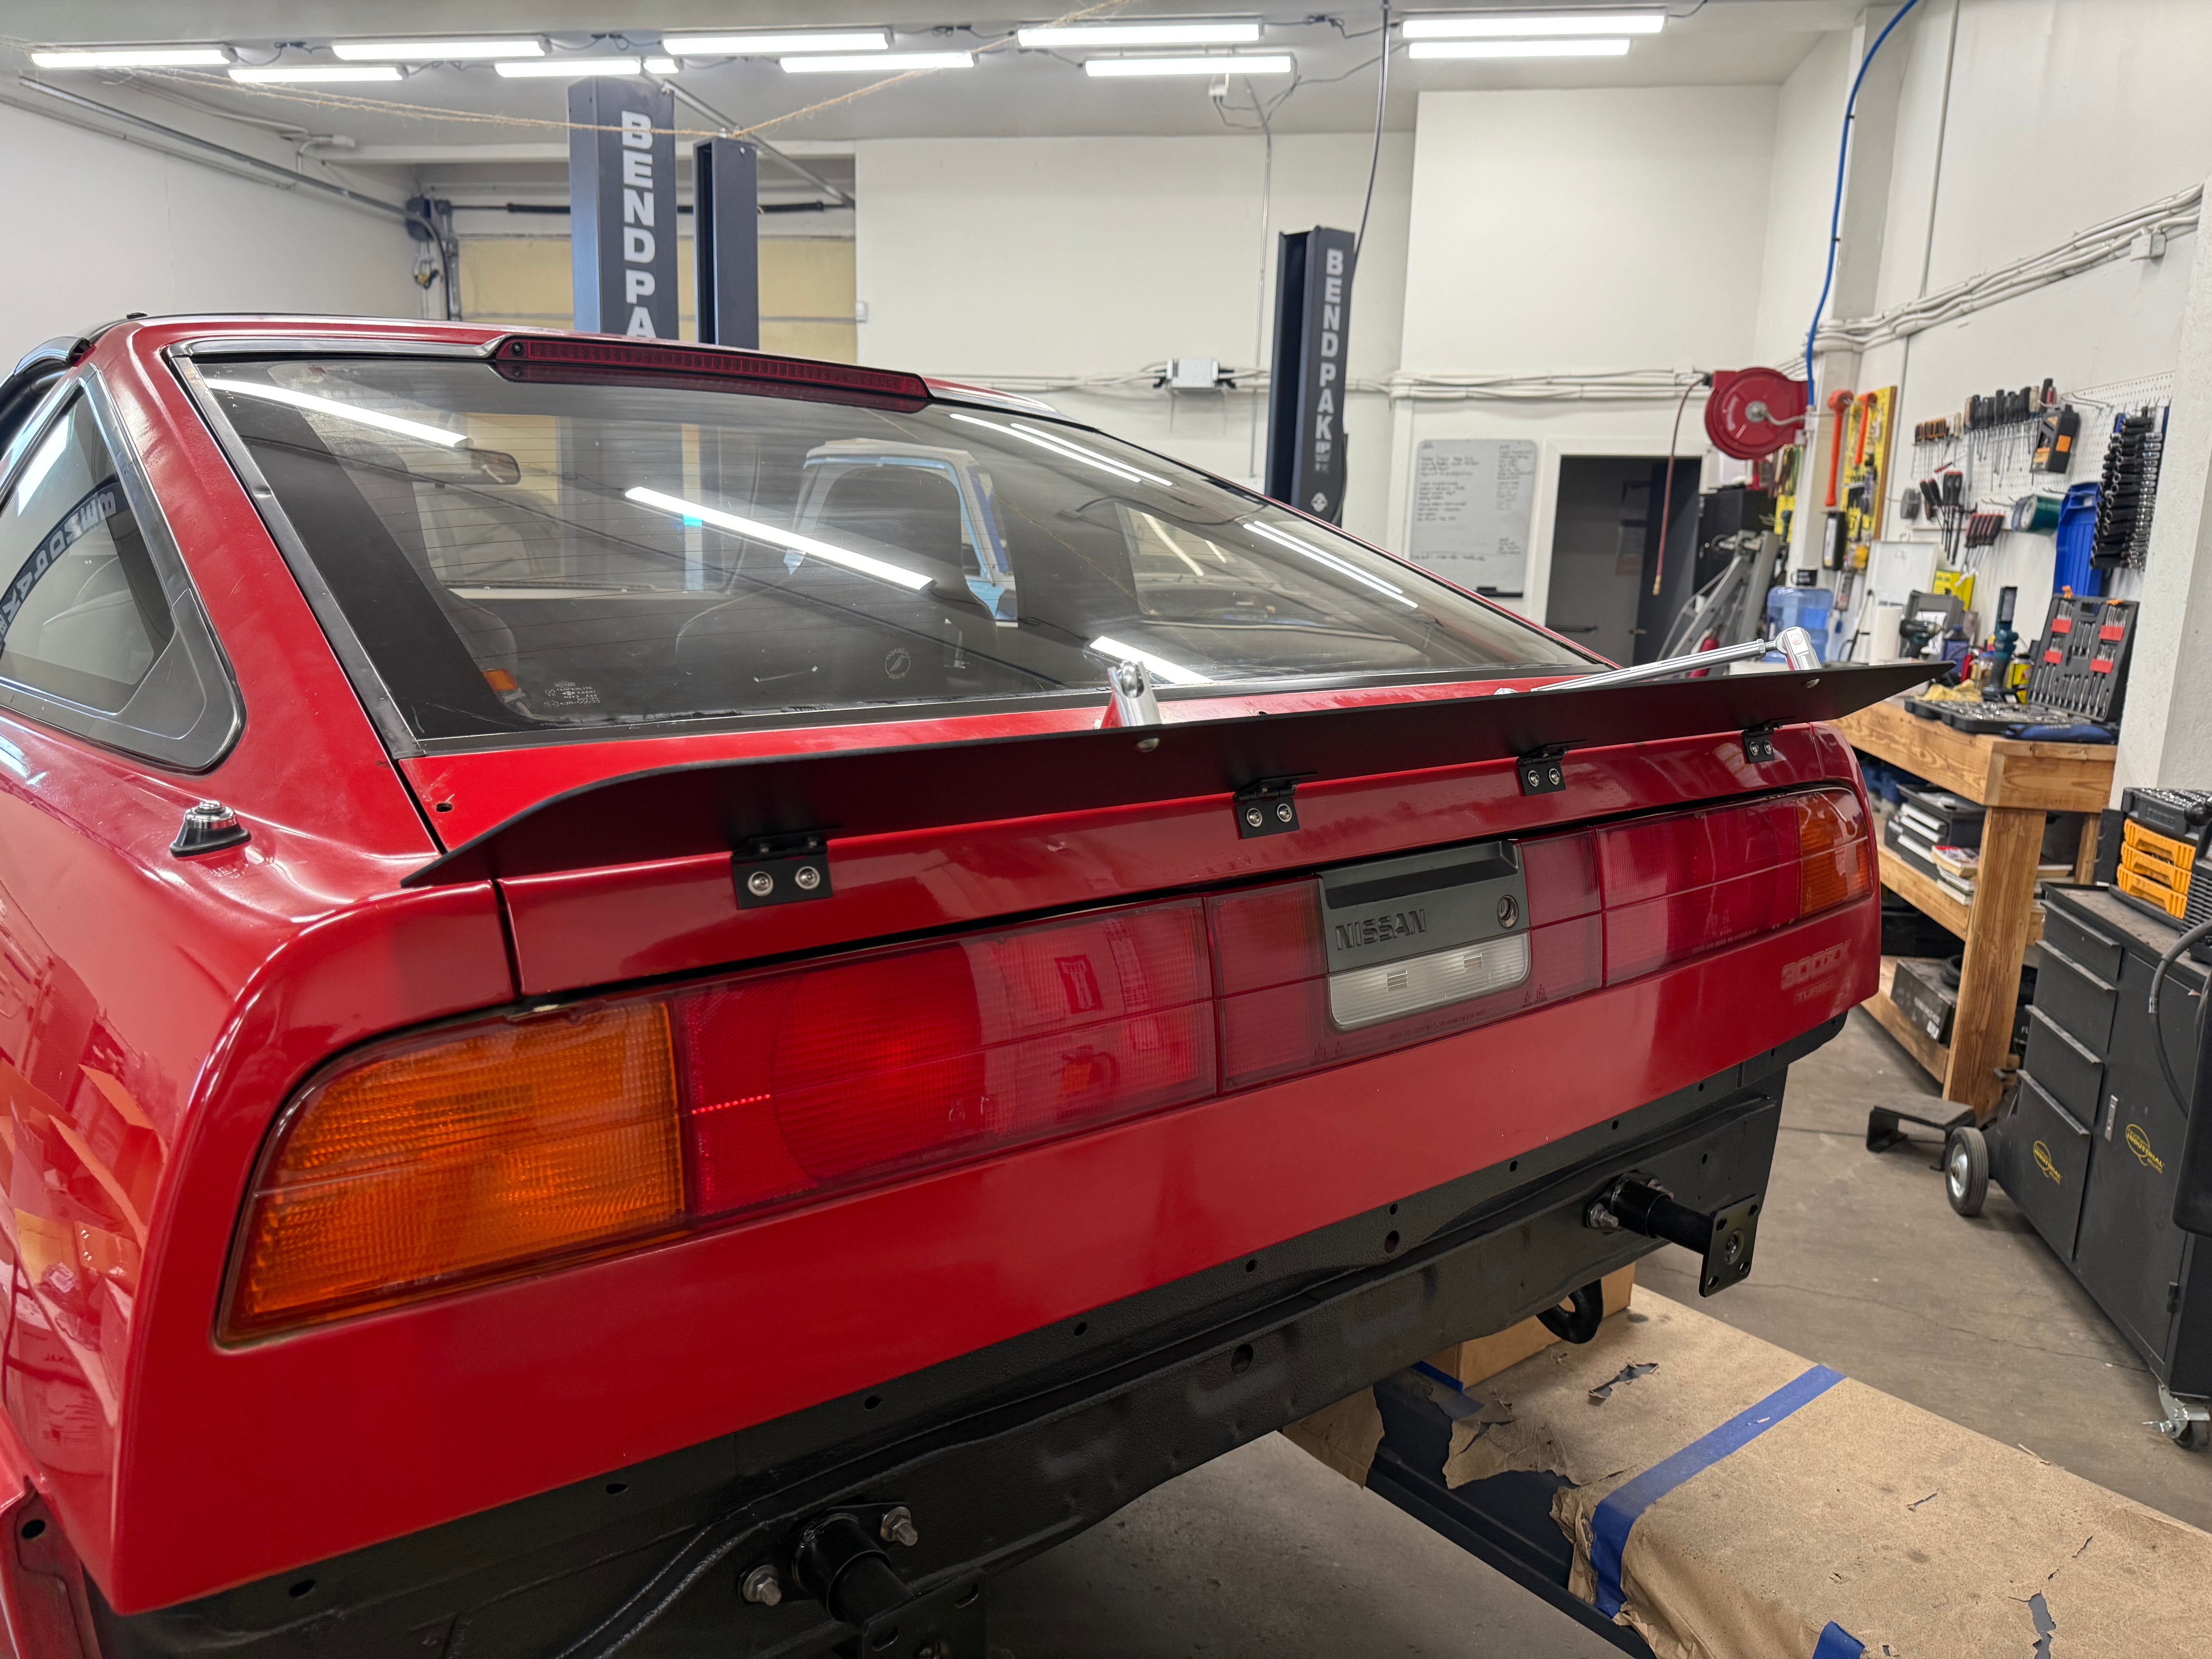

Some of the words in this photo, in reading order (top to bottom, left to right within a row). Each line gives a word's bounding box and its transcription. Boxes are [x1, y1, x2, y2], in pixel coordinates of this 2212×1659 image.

[1315, 248, 1344, 441] BENDPAK
[1335, 908, 1427, 951] NISSAN
[1781, 939, 1851, 991] 300ZX
